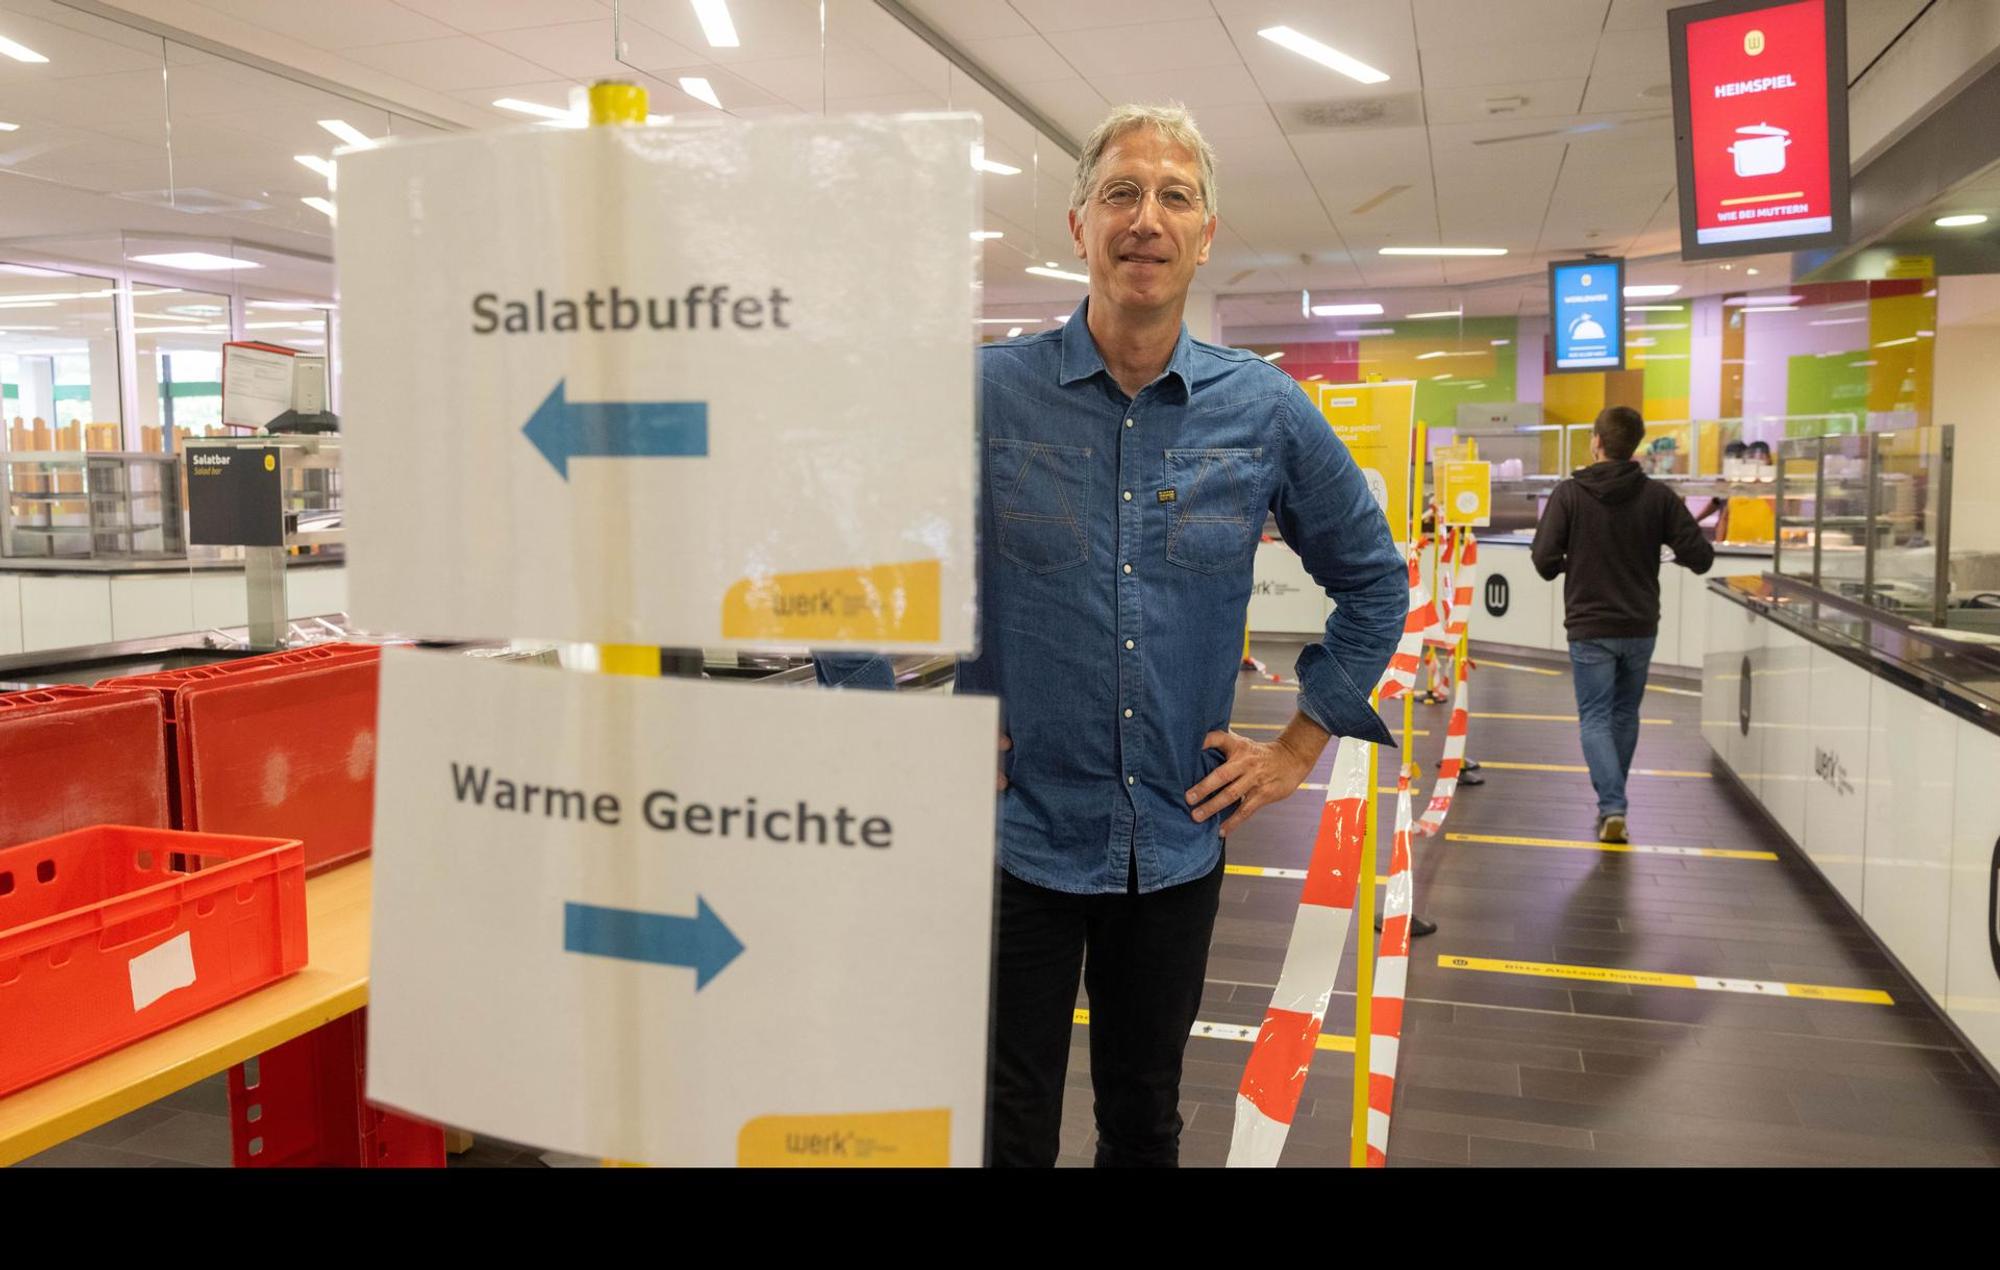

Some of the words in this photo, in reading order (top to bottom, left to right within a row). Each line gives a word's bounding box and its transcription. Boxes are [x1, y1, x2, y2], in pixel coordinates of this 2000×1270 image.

[1714, 73, 1796, 98] HEIMSPIEL
[1717, 211, 1737, 222] WIE
[1738, 209, 1755, 219] BEI
[1757, 203, 1808, 217] MUTTERN
[471, 284, 793, 336] Salatbuffet
[193, 454, 231, 465] Salatbar
[450, 762, 622, 826] Warme
[642, 790, 894, 849] Gerichte
